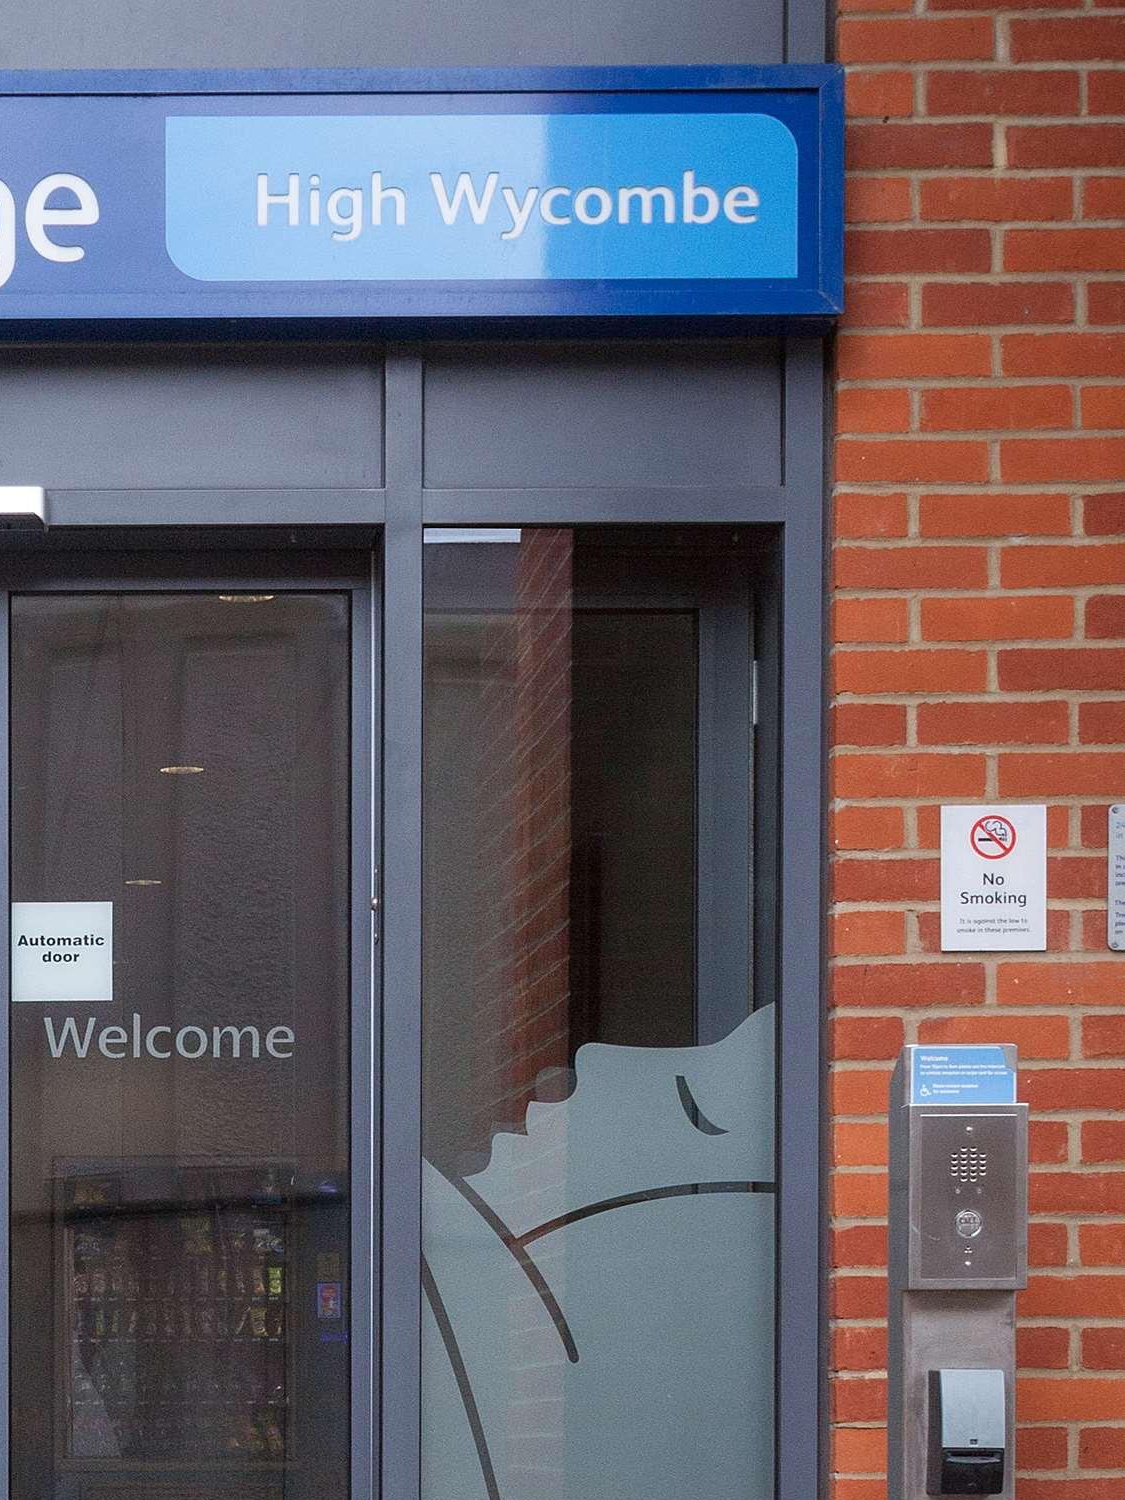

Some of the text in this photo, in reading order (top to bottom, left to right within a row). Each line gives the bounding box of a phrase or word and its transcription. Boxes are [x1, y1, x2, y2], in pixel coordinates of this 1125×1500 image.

[256, 169, 761, 242] High Wycombe
[982, 872, 1005, 886] No
[960, 891, 1027, 908] Smoking
[973, 918, 996, 927] against
[17, 934, 104, 948] Automatic
[42, 951, 80, 963] door
[44, 1013, 295, 1059] Welcome
